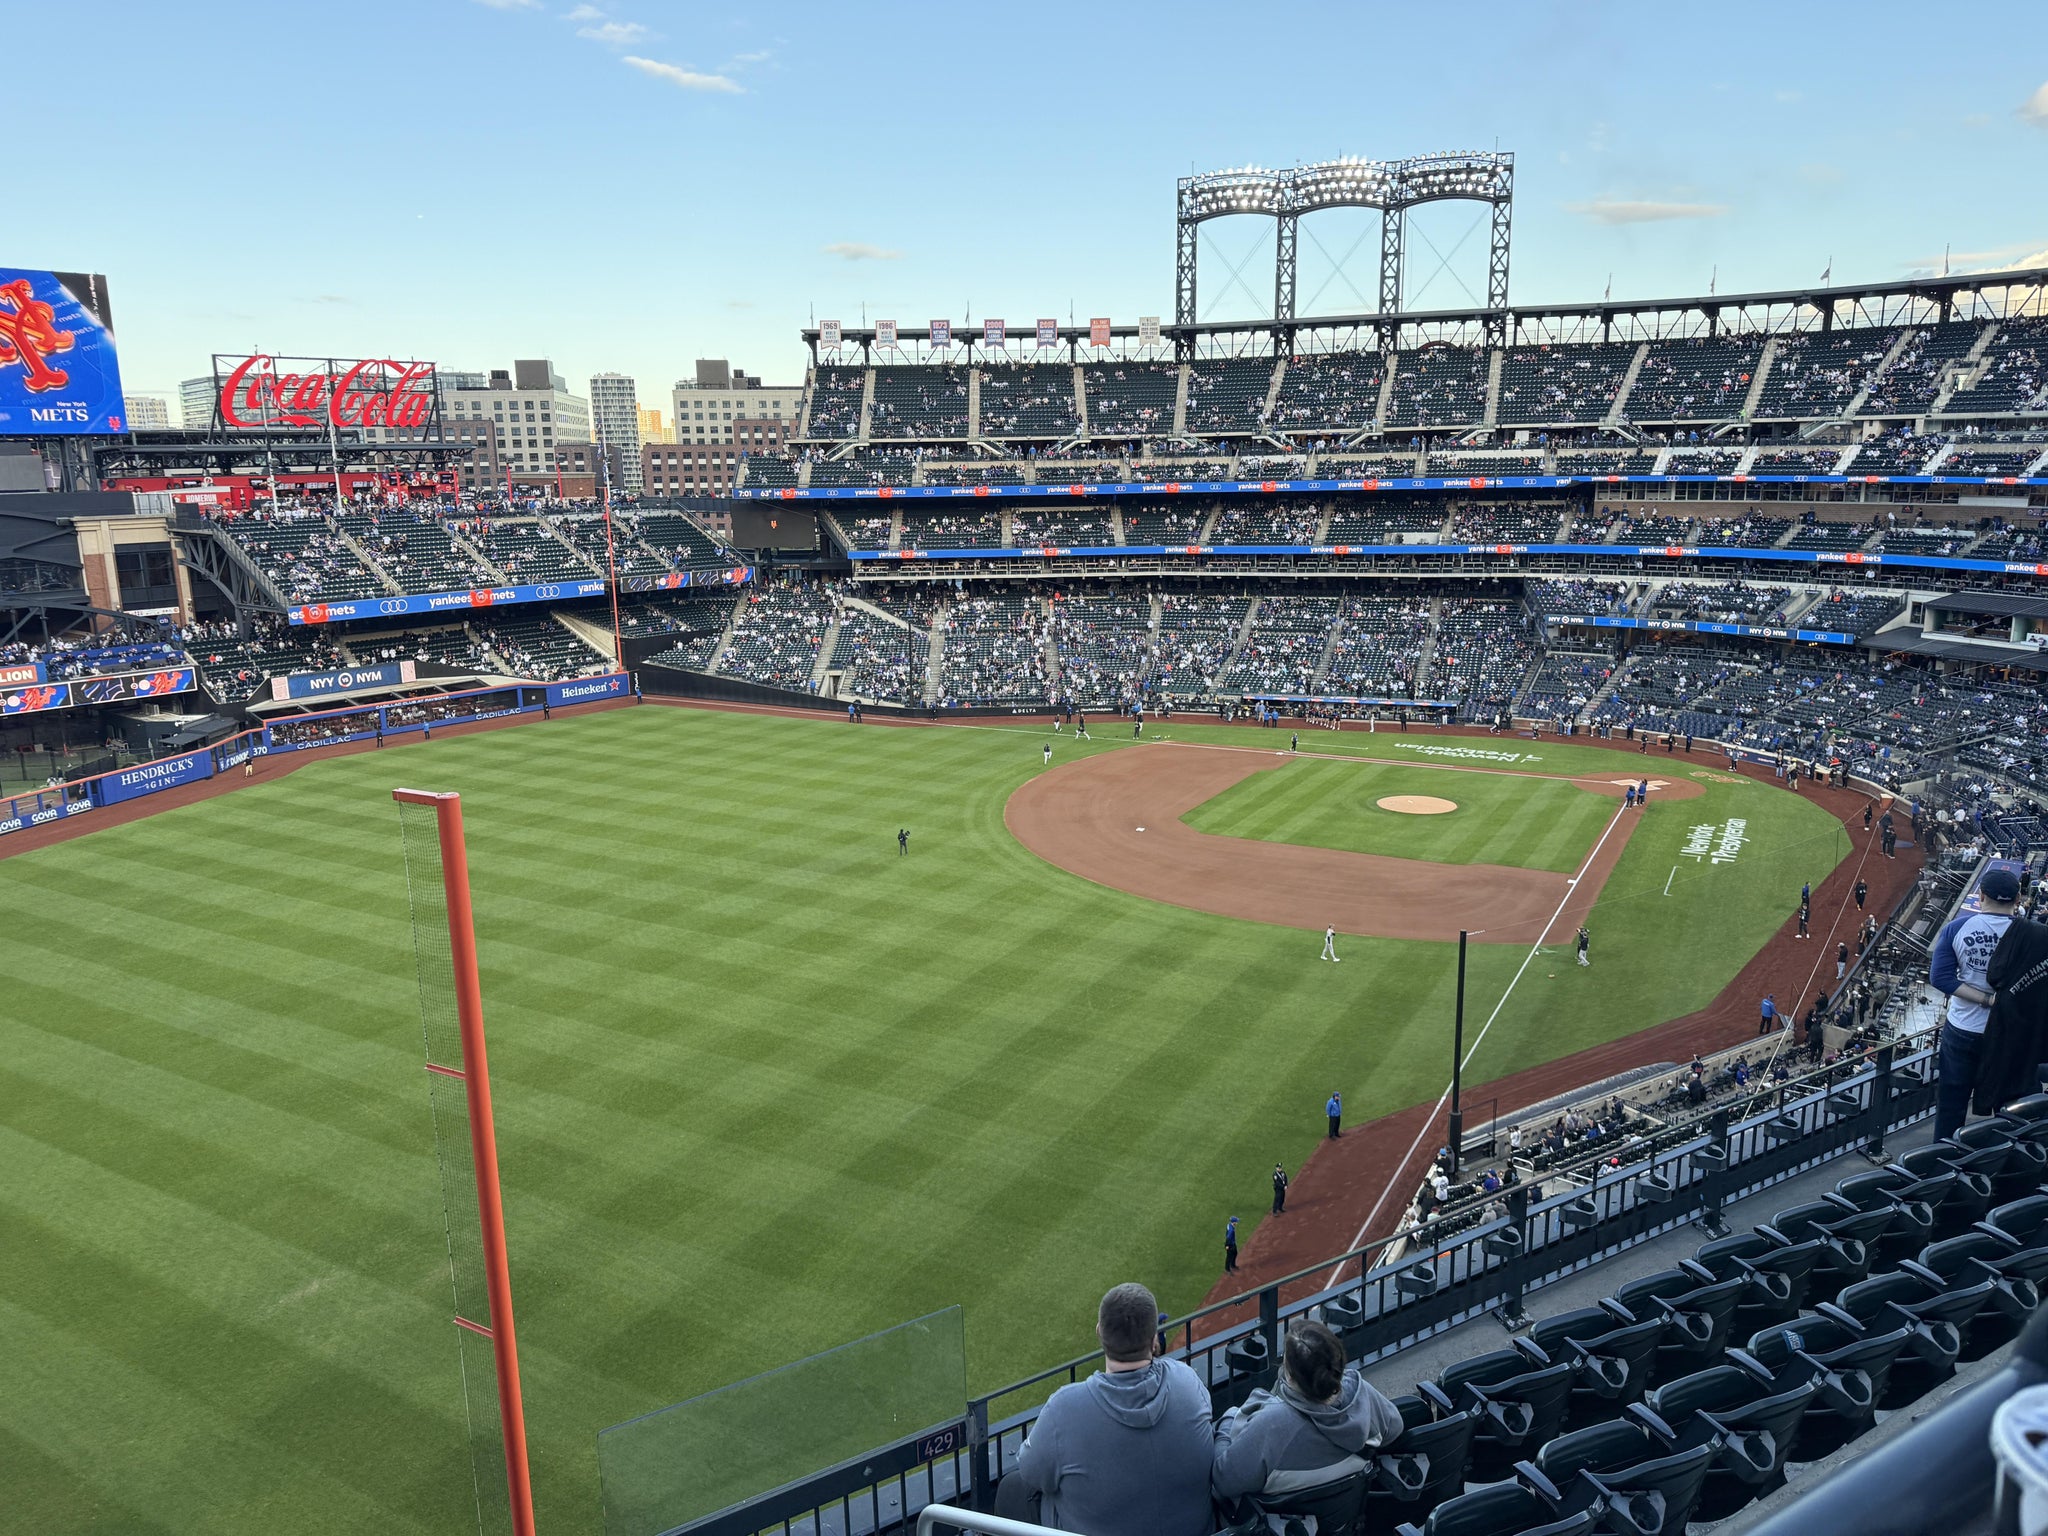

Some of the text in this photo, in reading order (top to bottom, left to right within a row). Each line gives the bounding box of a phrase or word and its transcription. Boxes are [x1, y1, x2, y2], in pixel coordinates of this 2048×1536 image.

[823, 322, 838, 330] 1969
[220, 354, 435, 428] Coca-Cola
[30, 408, 89, 422] METS
[1815, 552, 1882, 562] yankees mets
[2004, 562, 2038, 572] yankees
[429, 594, 472, 608] yankees
[489, 590, 516, 600] mets
[325, 605, 356, 616] mets
[1548, 616, 1562, 624] NYY
[1647, 620, 1686, 629] NYY NYM
[1749, 627, 1788, 637] NYY NYM
[310, 677, 334, 689] NYY
[356, 671, 382, 684] NYM
[561, 683, 607, 699] Heineken
[375, 702, 402, 710] CADILLAC
[475, 707, 521, 721] CADILLAC
[297, 735, 351, 750] CADILLAC
[253, 746, 268, 757] 370
[121, 757, 194, 786] HENDRICK'S
[150, 776, 171, 789] GIN
[66, 799, 91, 812] GOYA
[31, 809, 58, 822] GOYA
[1968, 957, 1987, 967] NEW
[2009, 972, 2030, 996] FIFTH
[924, 1432, 954, 1457] 429
